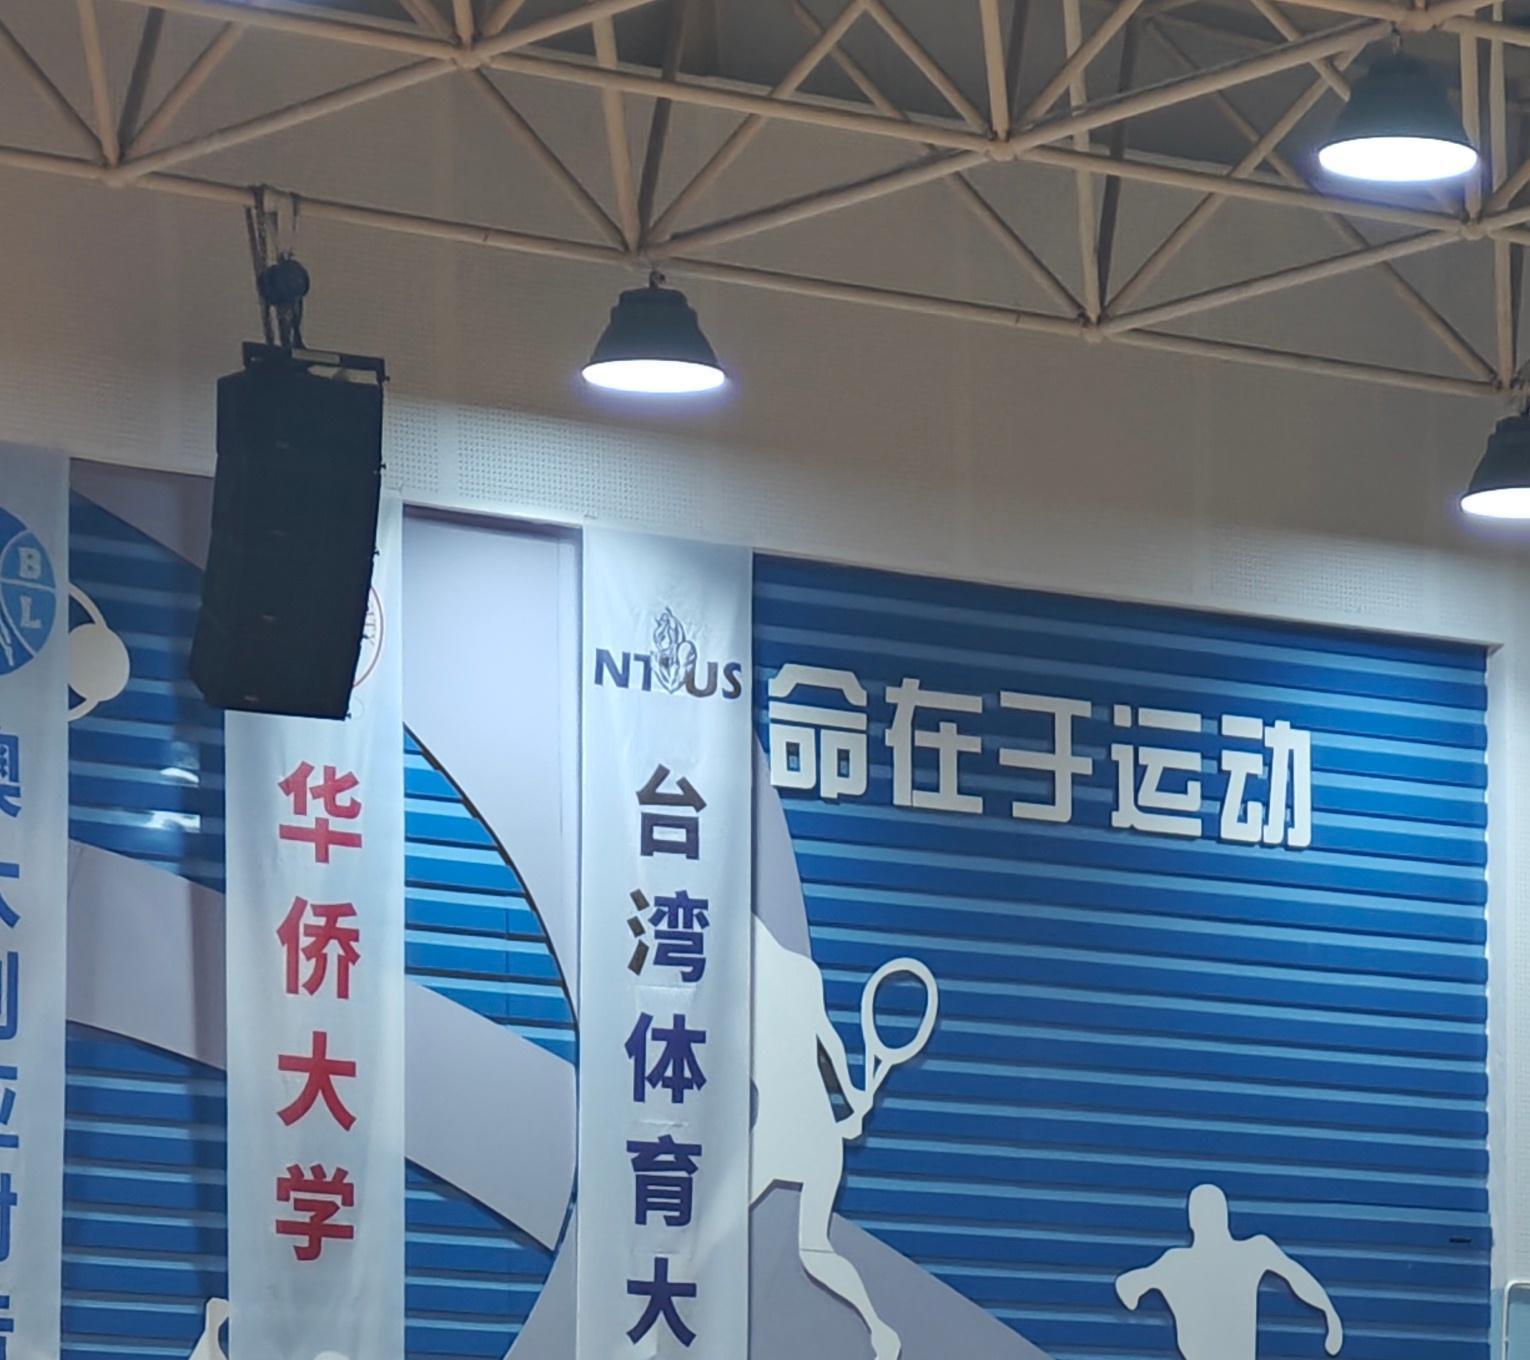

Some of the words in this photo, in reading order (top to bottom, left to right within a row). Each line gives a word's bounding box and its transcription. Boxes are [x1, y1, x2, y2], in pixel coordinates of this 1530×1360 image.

[768, 663, 1312, 849] 命在于运动
[275, 760, 364, 1262] 华侨大学
